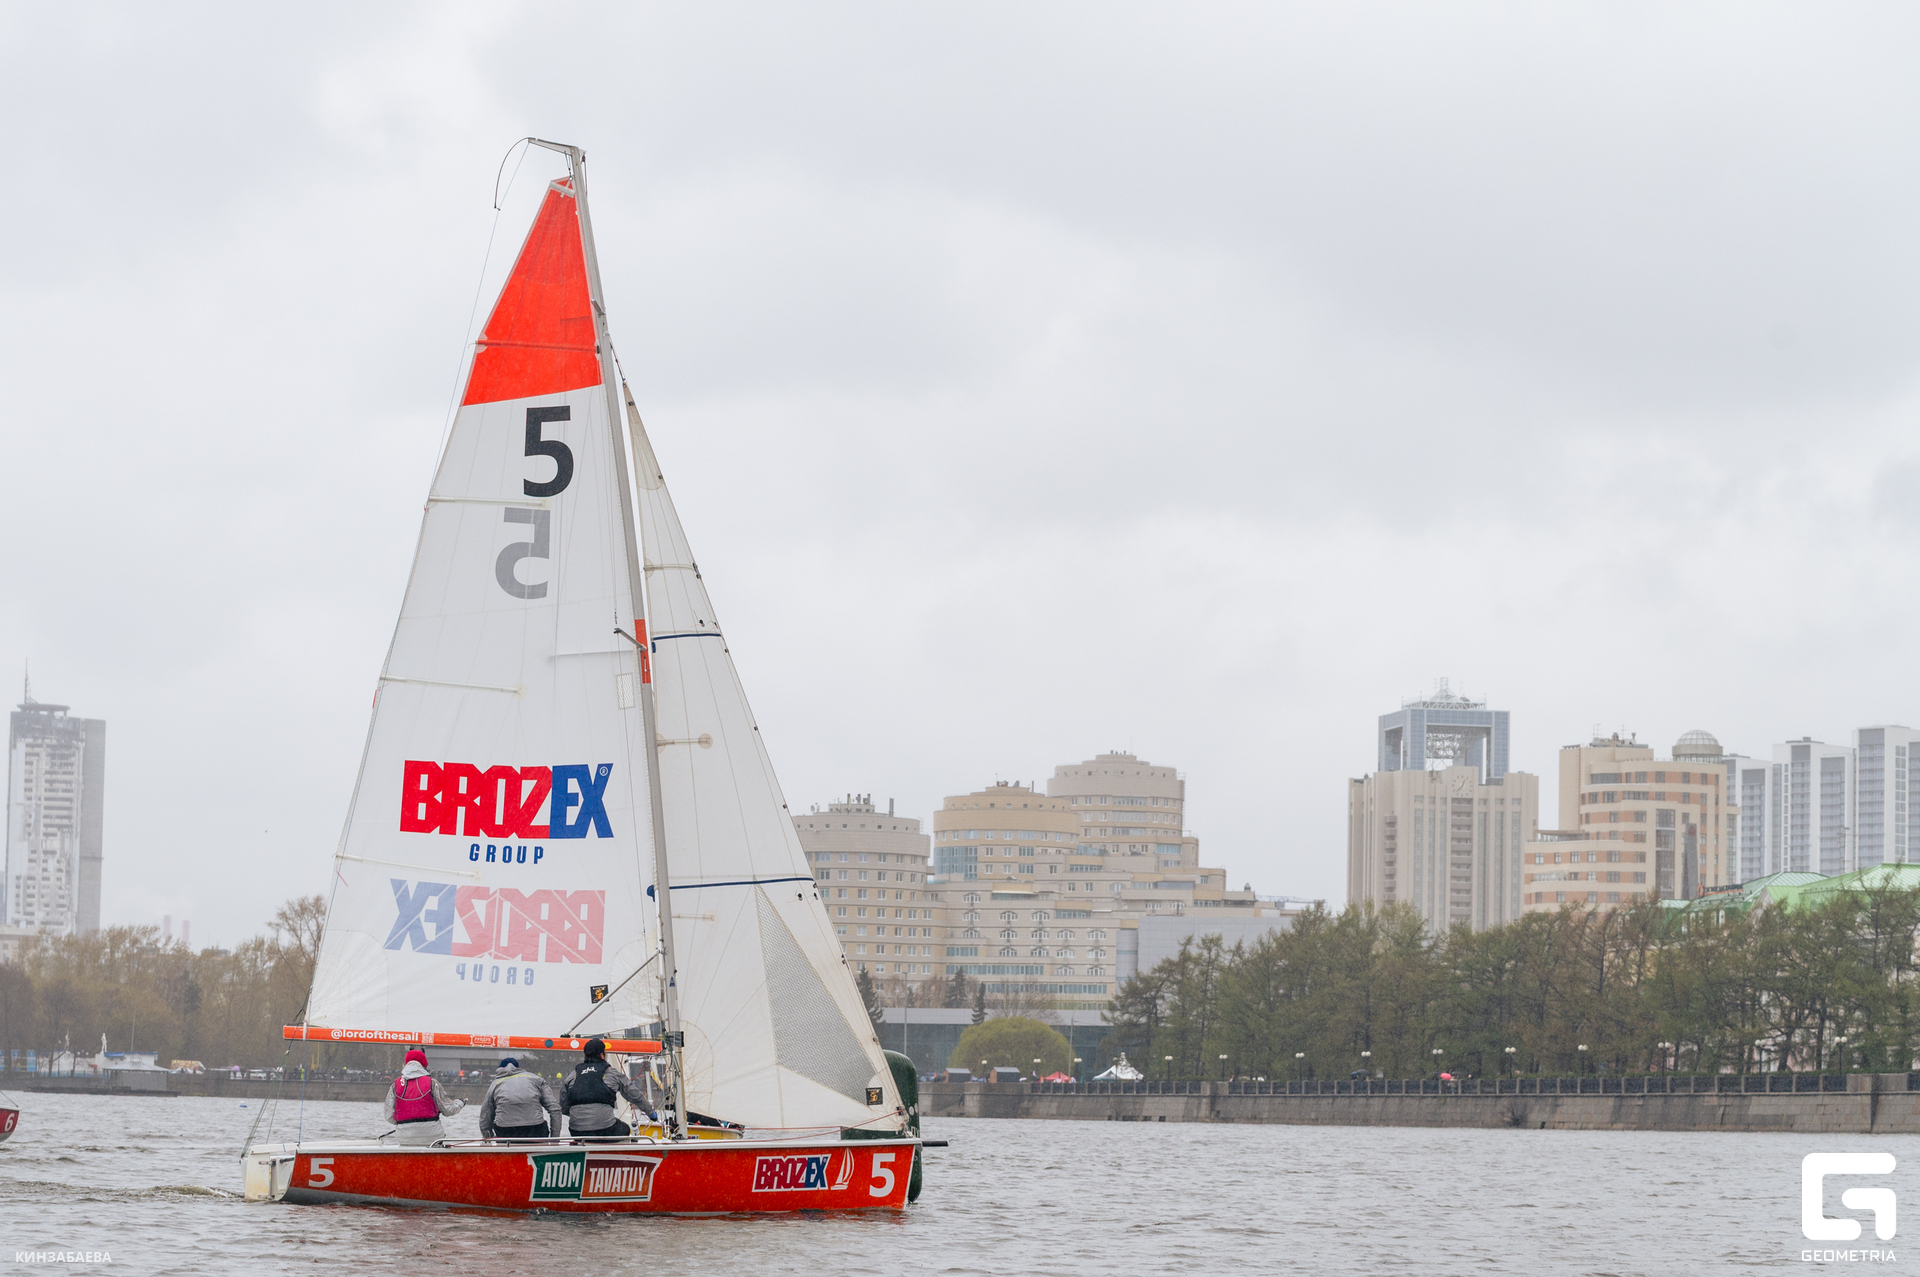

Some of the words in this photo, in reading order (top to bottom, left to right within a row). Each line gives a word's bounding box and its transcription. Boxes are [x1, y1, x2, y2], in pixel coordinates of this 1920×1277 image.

[523, 405, 574, 497] 5
[399, 760, 614, 839] BROZEX
[469, 843, 544, 864] GROUP
[330, 1028, 419, 1042] @lordofthesail
[4, 1113, 15, 1132] 6
[308, 1157, 335, 1188] 5
[541, 1162, 581, 1188] ATOM
[589, 1166, 647, 1193] TAVATUY
[753, 1154, 831, 1191] BROZEX
[869, 1153, 896, 1198] 5
